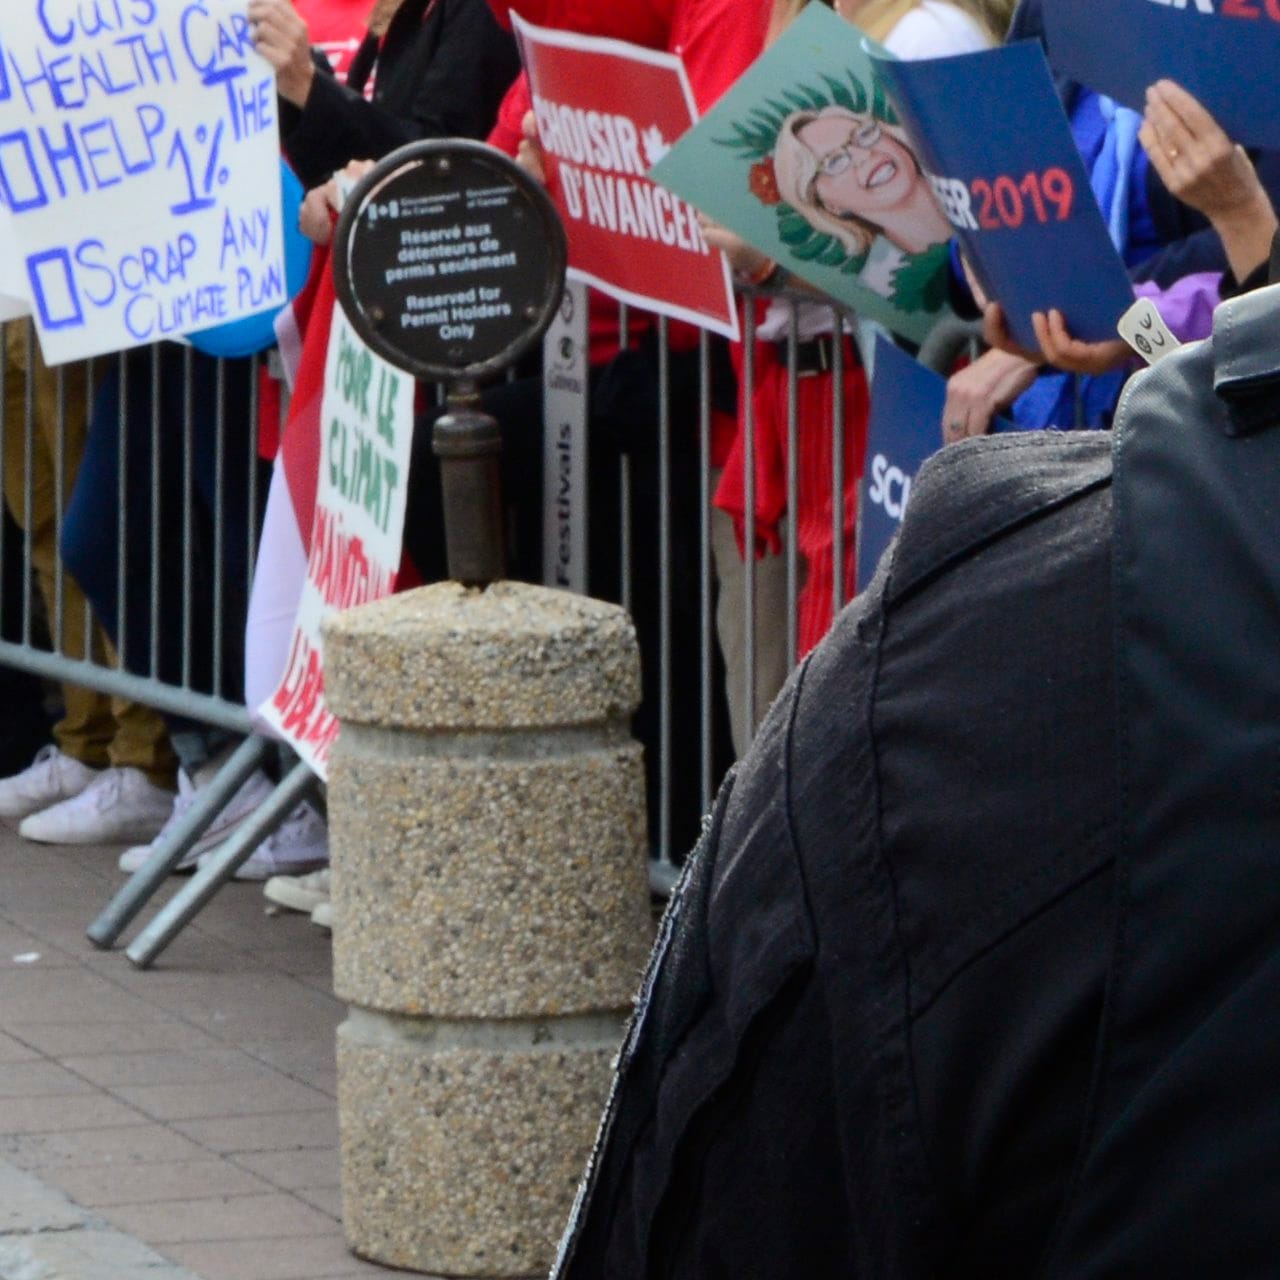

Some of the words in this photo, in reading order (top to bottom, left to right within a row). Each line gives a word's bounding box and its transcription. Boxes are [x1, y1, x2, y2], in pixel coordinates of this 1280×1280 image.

[7, 27, 178, 116] HEALTH
[37, 103, 167, 199] HELP
[201, 66, 274, 143] THE
[532, 95, 647, 175] CHOISIR
[167, 117, 230, 217] 1%
[970, 166, 1074, 230] 2019
[74, 231, 197, 307] SCRAP
[219, 206, 270, 271] ANY
[397, 242, 477, 264] détenteurs
[479, 237, 500, 253] de
[401, 224, 462, 245] Réservé
[465, 223, 492, 238] aux
[385, 263, 436, 285] permis
[438, 251, 517, 275] seulement
[124, 285, 227, 341] CLIMATE
[400, 308, 449, 329] Permit
[452, 302, 512, 322] Holders
[406, 287, 476, 311] Reserved
[478, 286, 501, 301] for
[439, 322, 475, 340] Only
